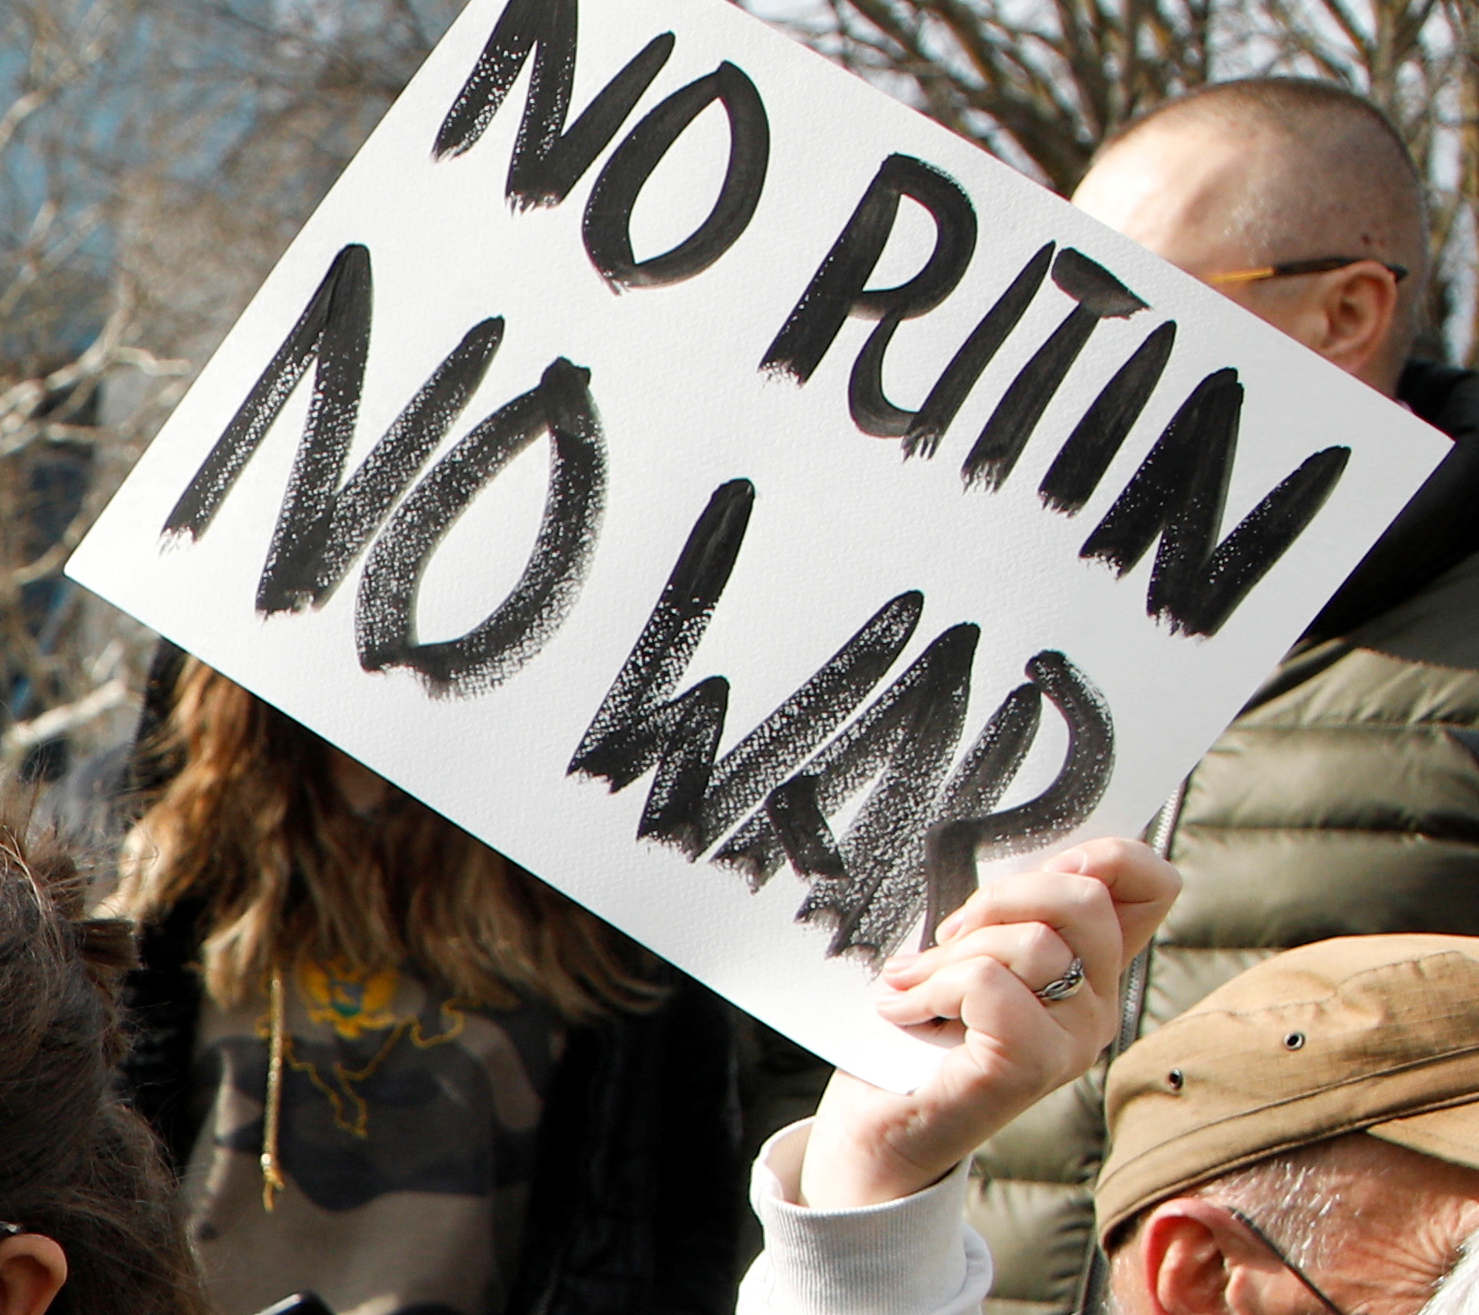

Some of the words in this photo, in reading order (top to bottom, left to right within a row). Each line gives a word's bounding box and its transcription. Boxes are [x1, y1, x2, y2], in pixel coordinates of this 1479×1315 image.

[159, 243, 610, 700] NO
[566, 478, 1116, 985] WAR
[431, 0, 770, 296] NO
[757, 152, 1352, 642] PUTIN
